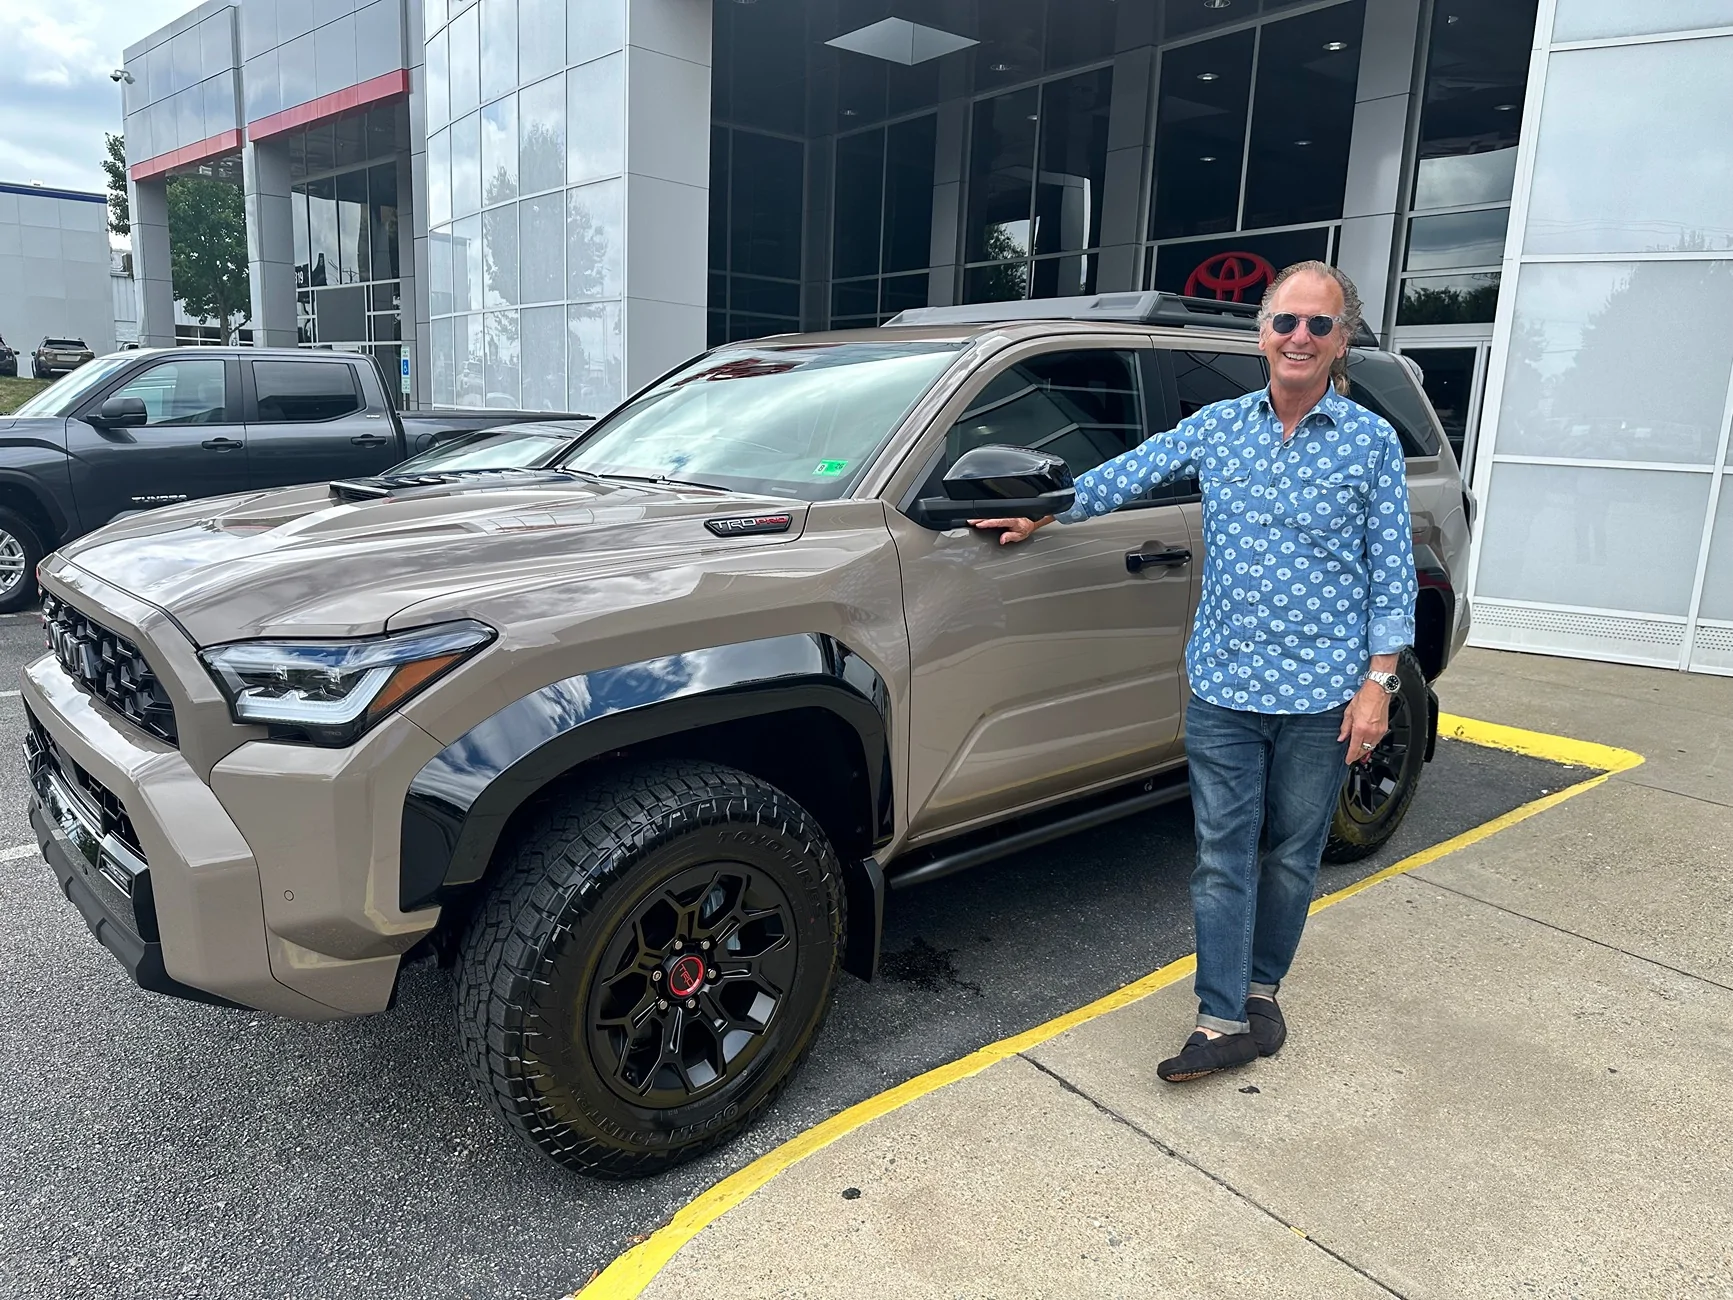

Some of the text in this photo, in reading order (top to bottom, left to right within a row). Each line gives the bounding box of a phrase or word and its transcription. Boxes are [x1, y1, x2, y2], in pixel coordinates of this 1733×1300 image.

[711, 518, 756, 530] TRD
[679, 963, 695, 988] TRD
[667, 1101, 739, 1144] OPEN
